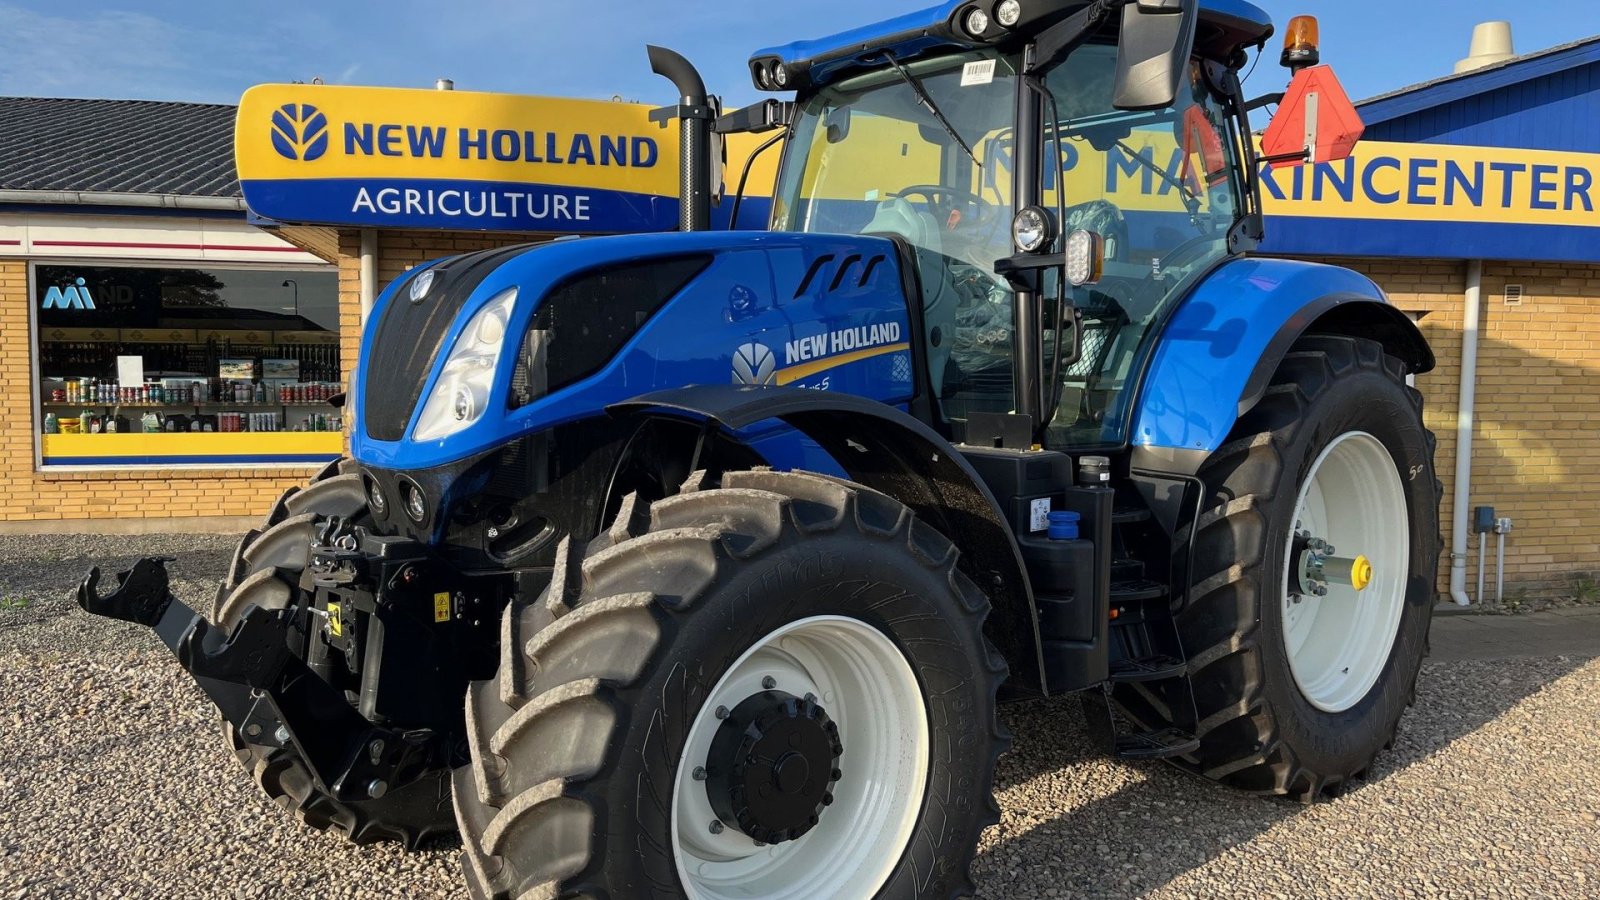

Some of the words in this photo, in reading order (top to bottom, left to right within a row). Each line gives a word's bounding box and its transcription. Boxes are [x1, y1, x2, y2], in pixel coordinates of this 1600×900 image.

[343, 121, 447, 158] NEW
[458, 128, 659, 168] HOLLAND
[1105, 144, 1593, 212] MAKINCENTER
[351, 187, 591, 221] AGRICULTURE
[785, 333, 828, 365] NEW
[831, 321, 900, 353] HOLLAND
